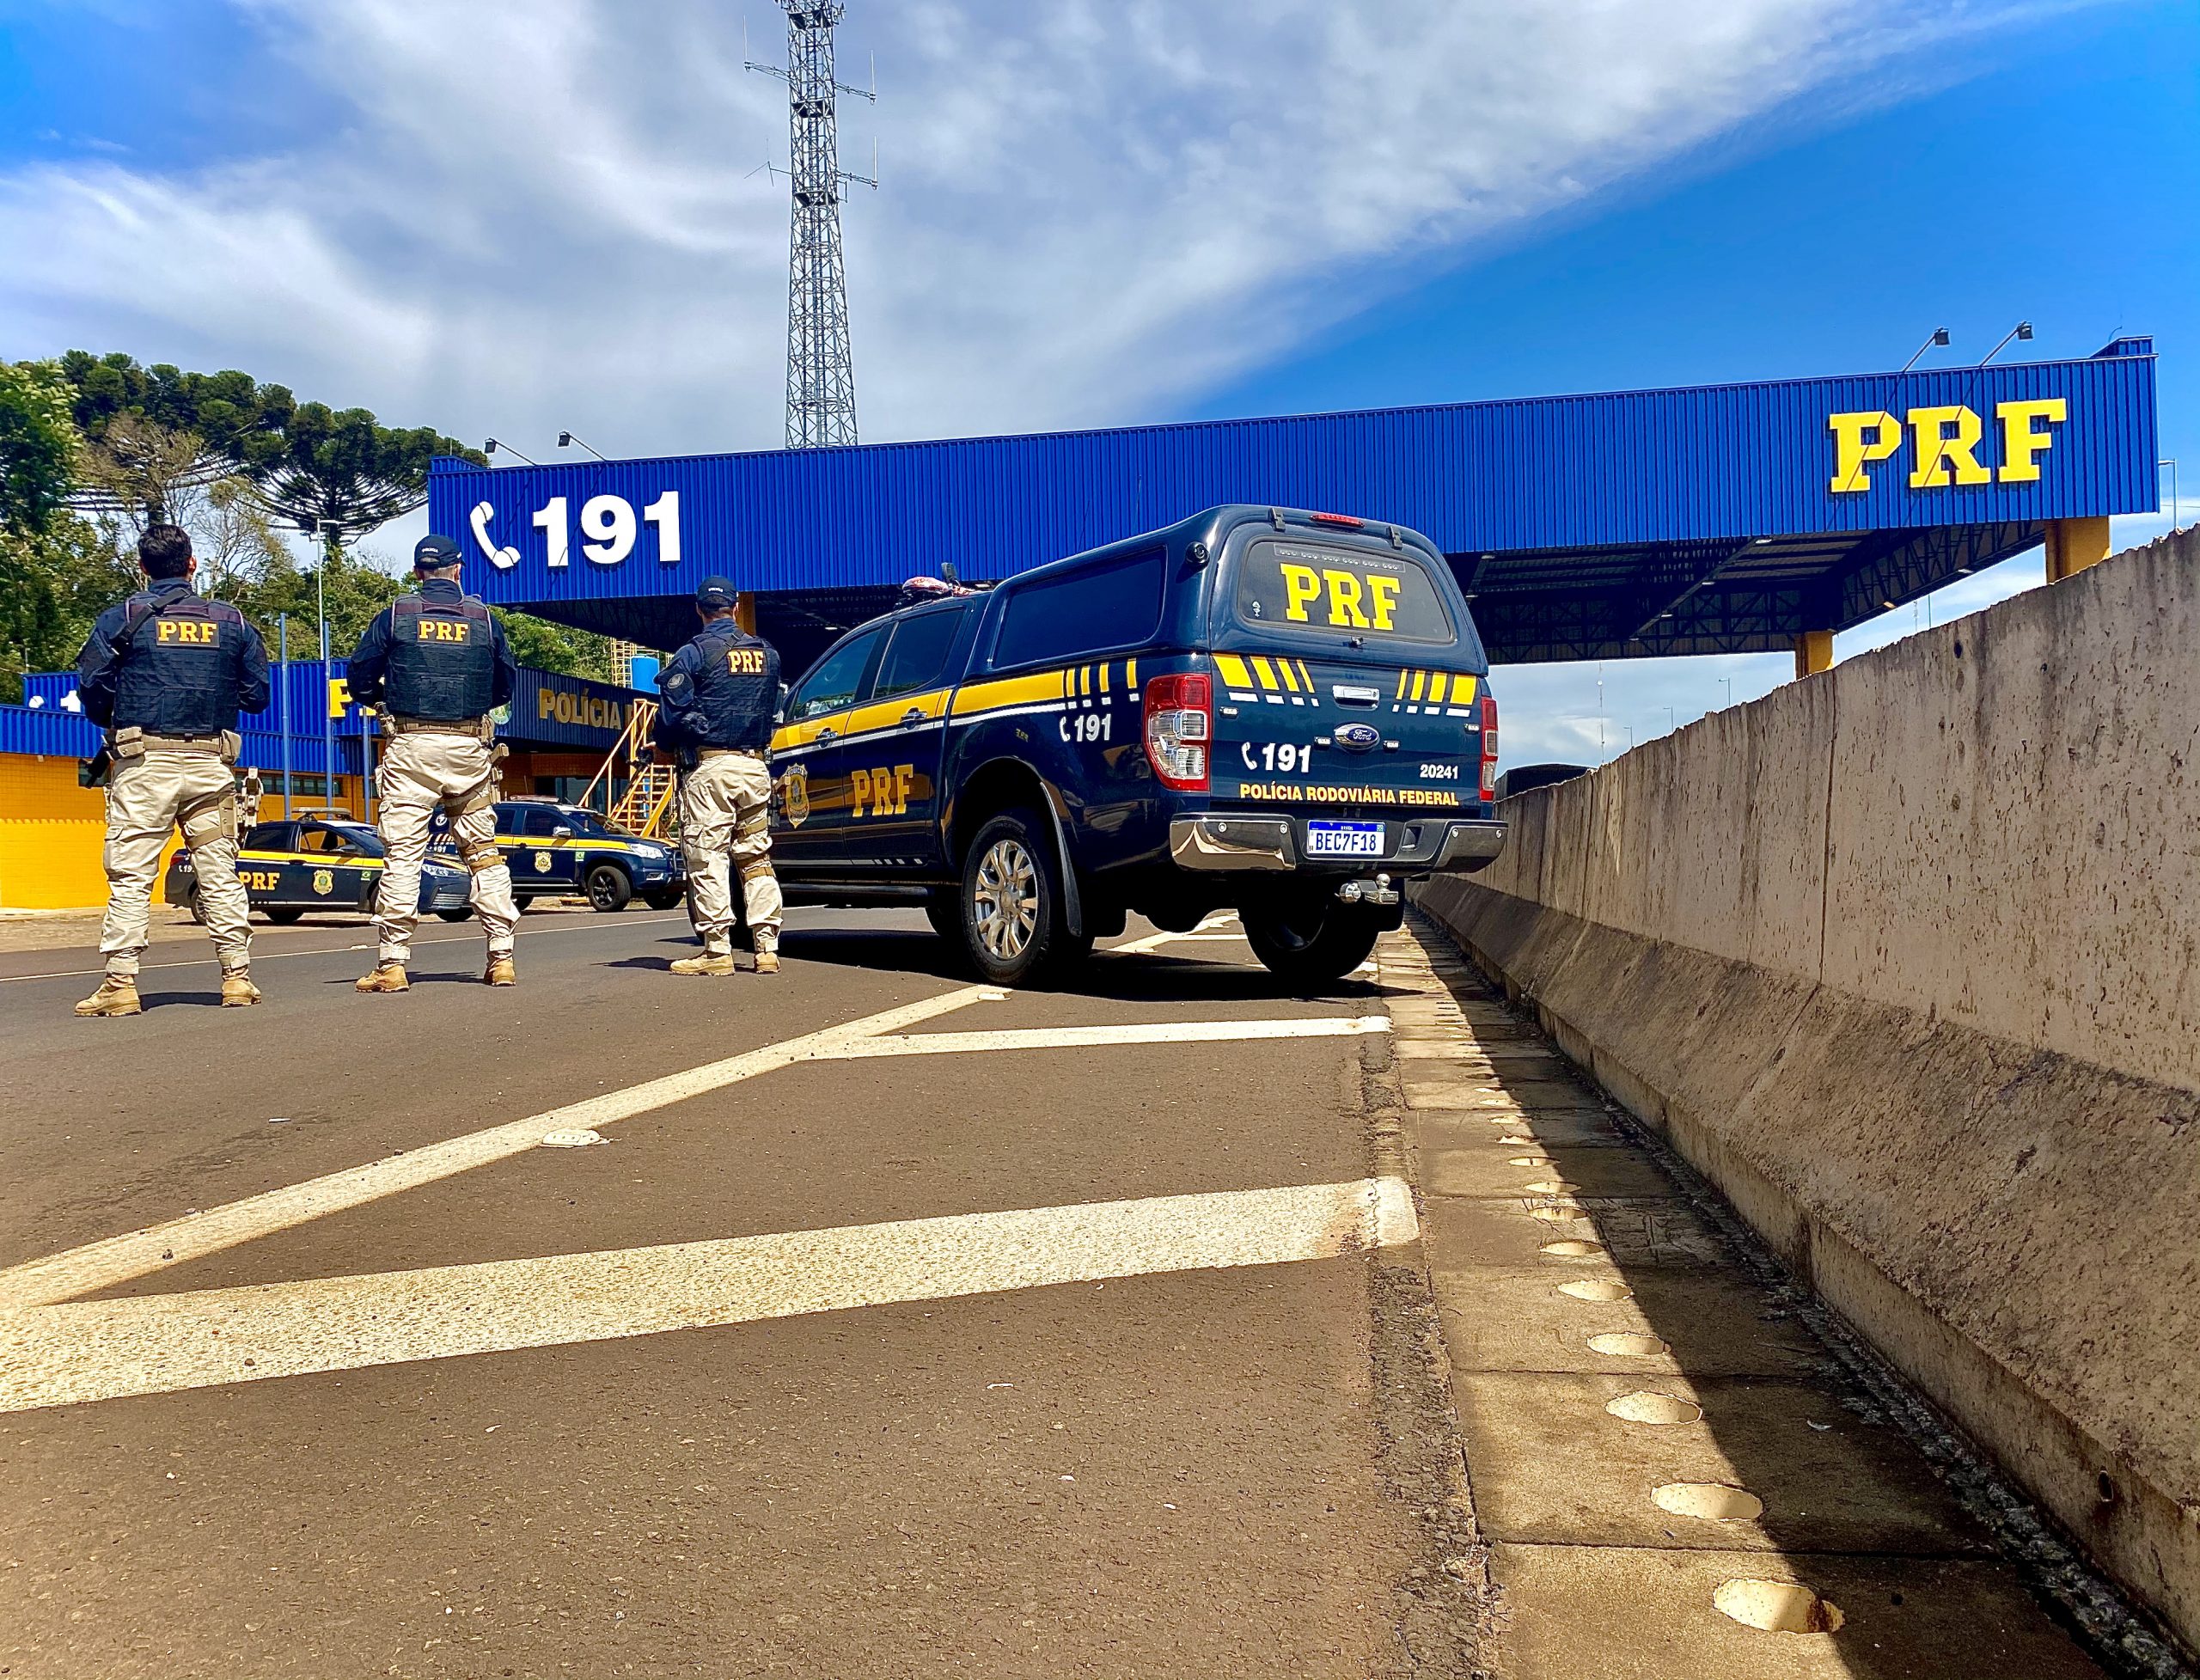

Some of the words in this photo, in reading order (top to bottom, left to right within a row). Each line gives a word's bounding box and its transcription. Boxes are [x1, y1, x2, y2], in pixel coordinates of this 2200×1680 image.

[1829, 398, 2068, 492] PRF
[532, 490, 681, 567] 191
[1280, 563, 1402, 631] PRF
[157, 620, 217, 644] PRF
[419, 620, 469, 642] PRF
[728, 650, 765, 674] PRF
[539, 687, 622, 730] POLÍCIA
[1074, 713, 1112, 742] 191
[1353, 729, 1372, 741] Ford
[1262, 742, 1311, 773] 191
[1420, 764, 1459, 779] 20241
[852, 763, 914, 817] PRF
[1240, 781, 1304, 801] POLÍCIA
[1305, 785, 1396, 803] RODOVIÁRIA
[1398, 790, 1460, 806] FEDERAL
[1316, 832, 1377, 852] BEC7F18
[183, 864, 195, 873] 19
[238, 871, 280, 890] PRF
